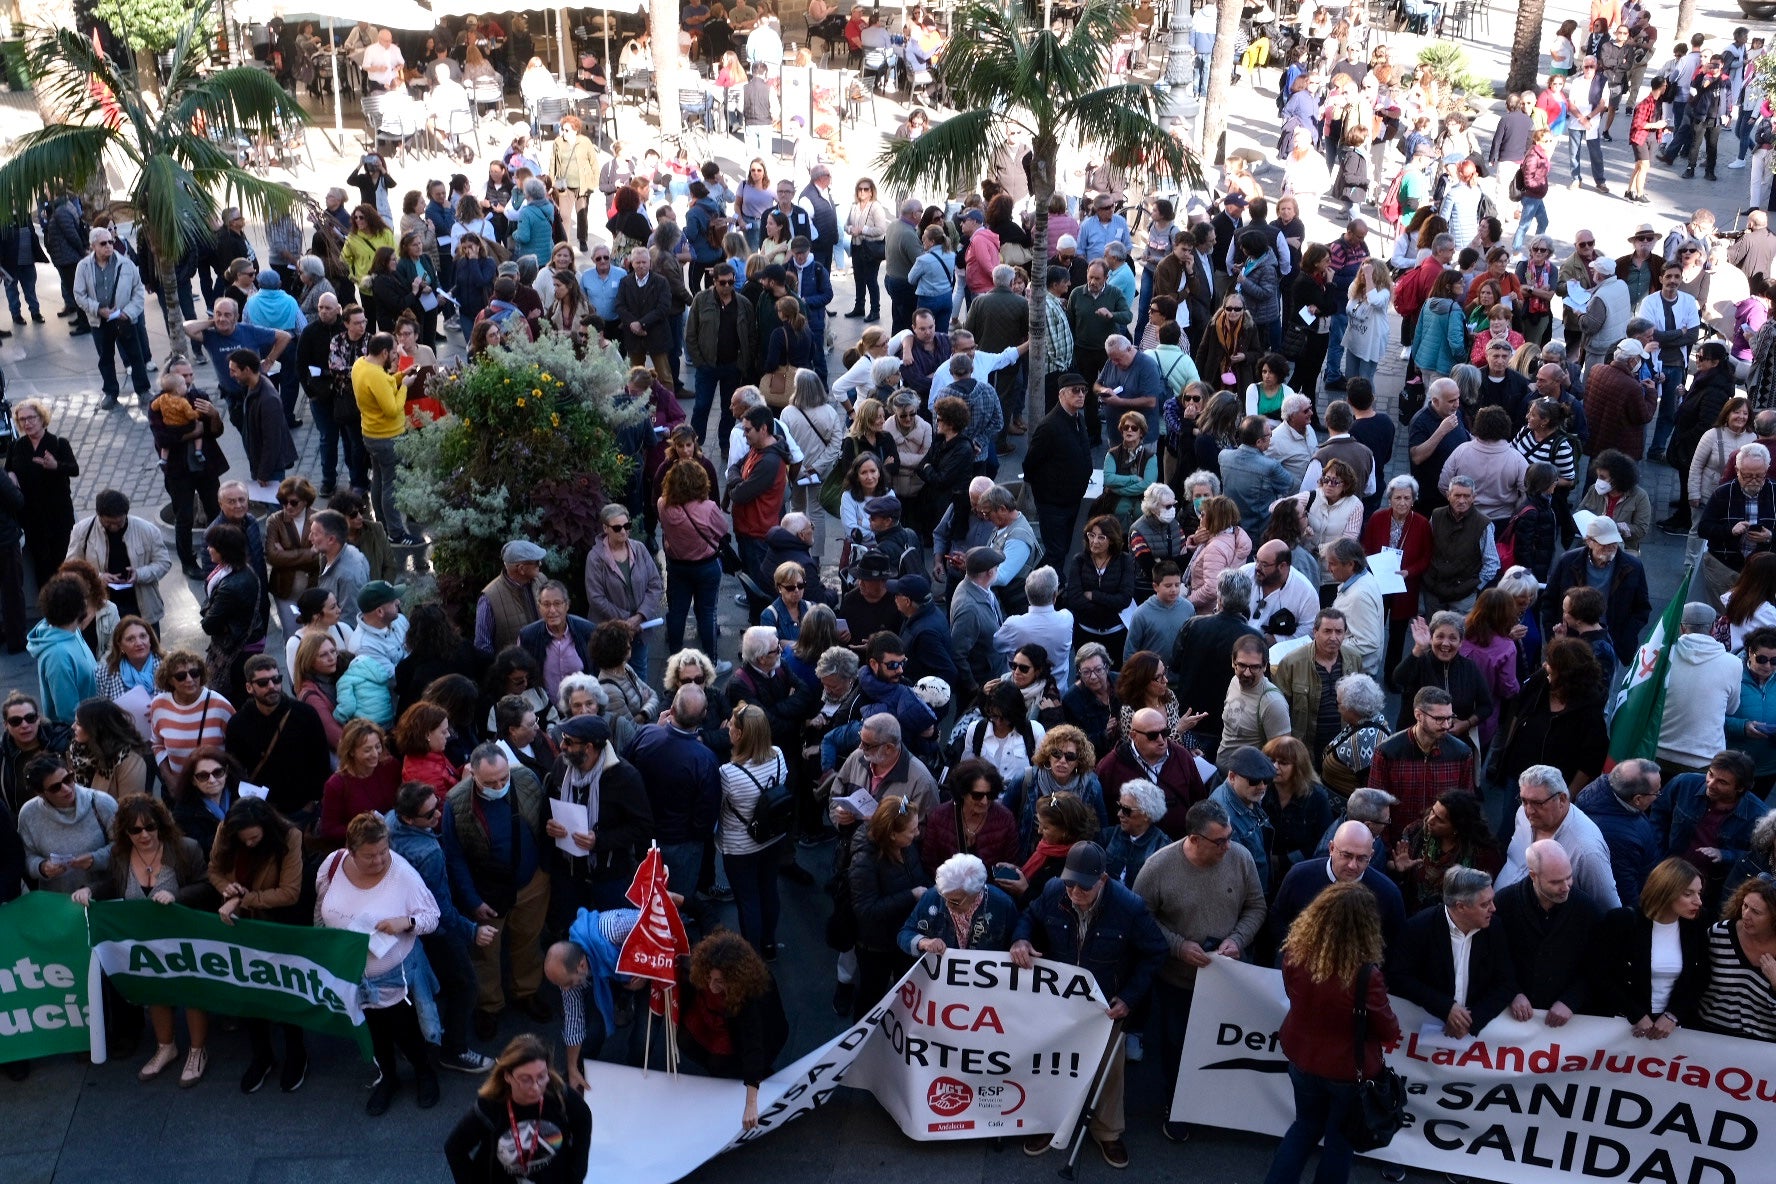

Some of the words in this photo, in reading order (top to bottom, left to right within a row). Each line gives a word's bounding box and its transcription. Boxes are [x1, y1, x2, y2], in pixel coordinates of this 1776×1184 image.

[129, 942, 348, 1012] Adelante
[634, 951, 673, 969] ugt.es
[1031, 1052, 1080, 1078] !!!
[935, 1082, 963, 1096] UGT
[1436, 1081, 1759, 1152] SANIDAD
[1423, 1118, 1737, 1184] CALIDAD
